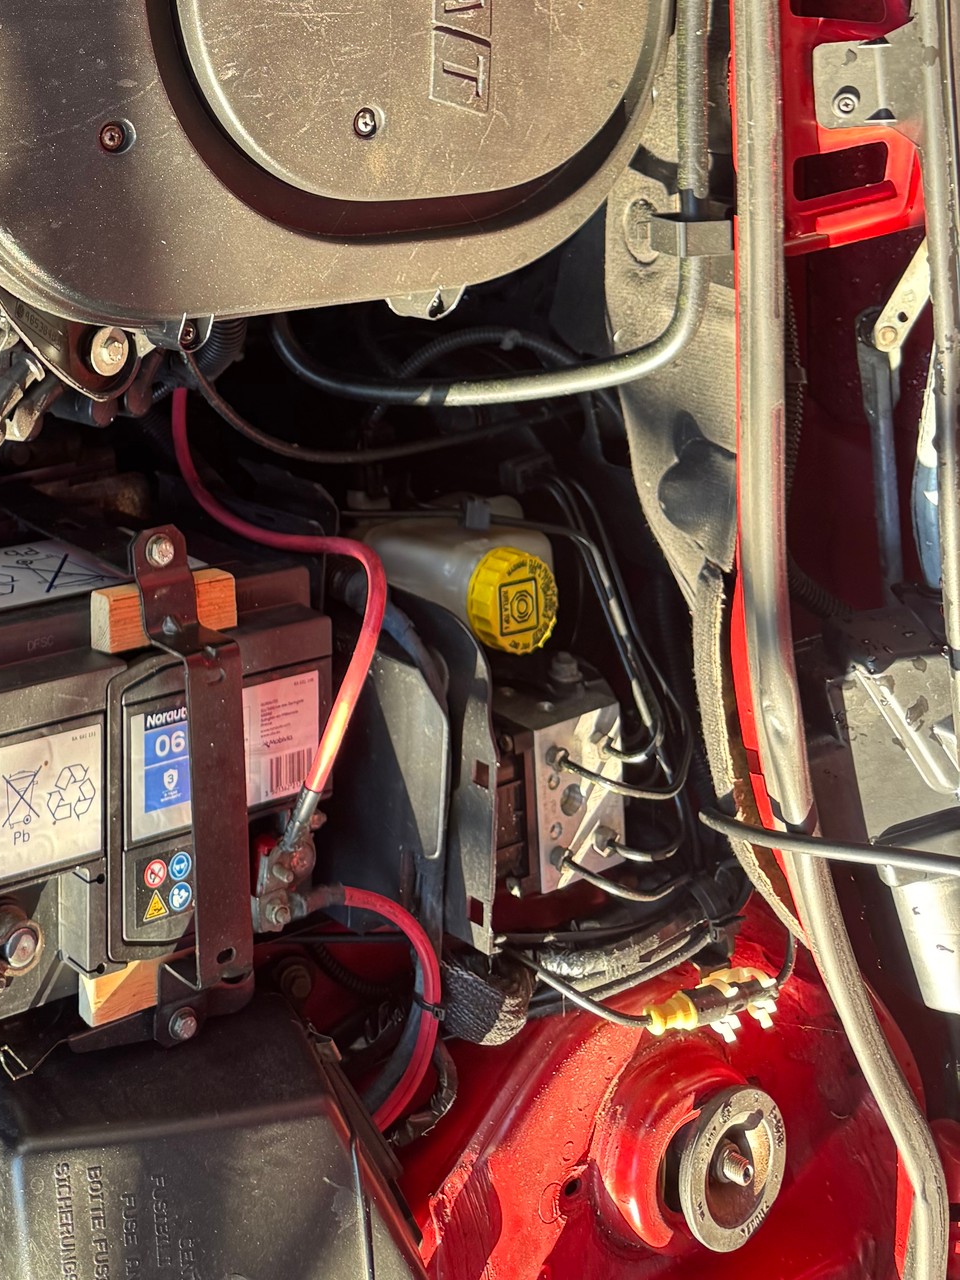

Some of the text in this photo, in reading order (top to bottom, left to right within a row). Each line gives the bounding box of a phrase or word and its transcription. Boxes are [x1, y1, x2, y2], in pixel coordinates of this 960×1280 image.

[146, 707, 188, 728] Noraut
[155, 730, 186, 758] 06
[167, 773, 174, 785] 3
[13, 829, 31, 846] Pb
[86, 1164, 107, 1231] BOITE
[119, 1191, 139, 1247] FUSE
